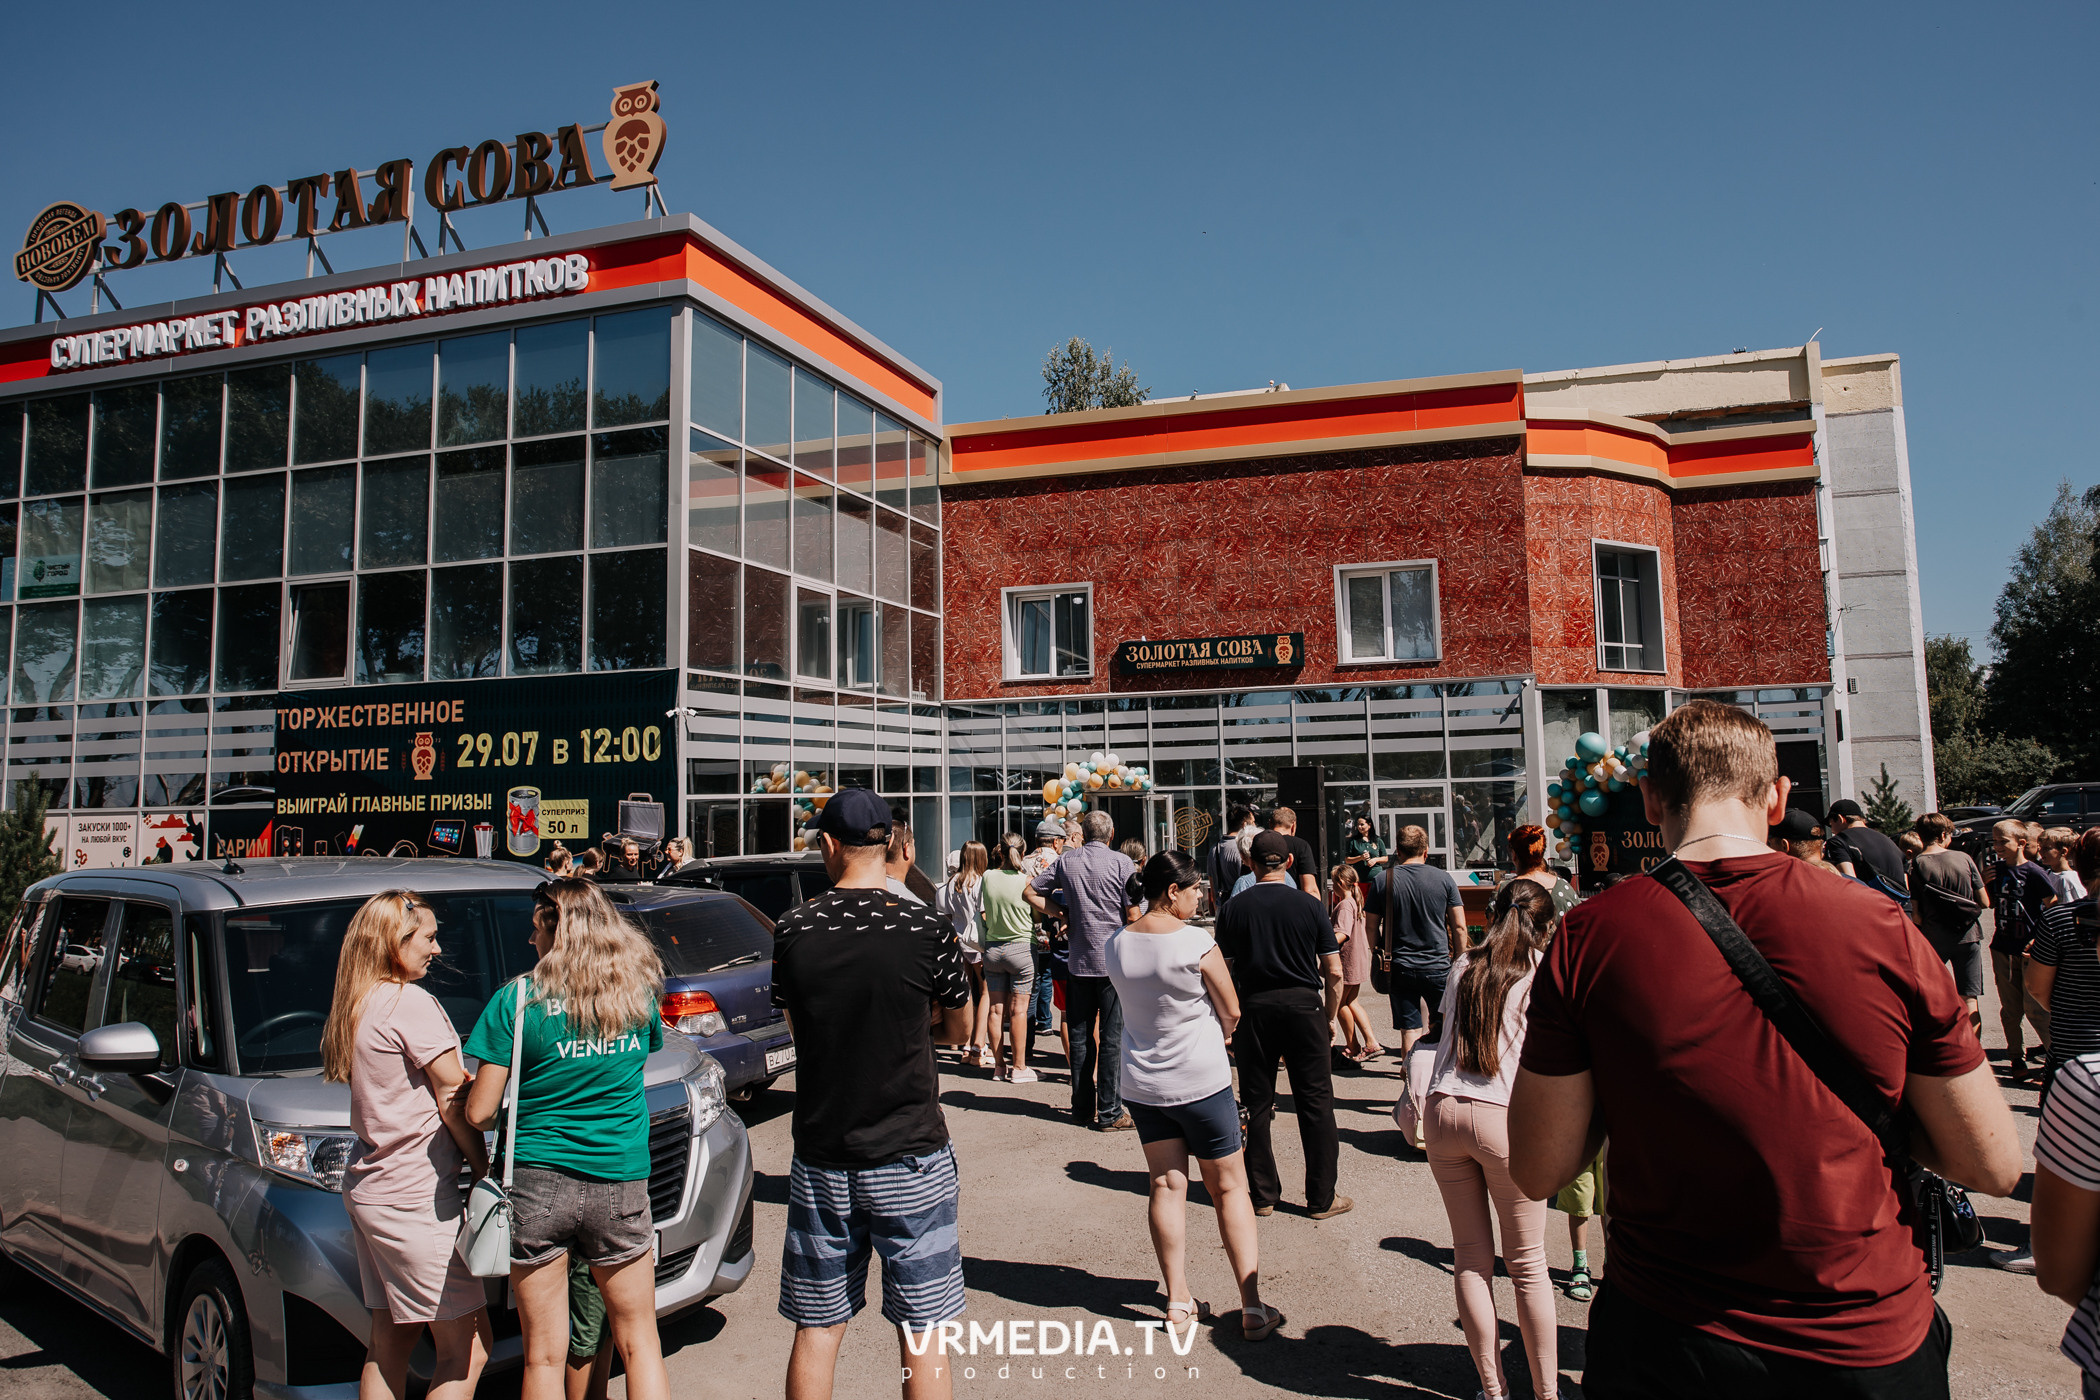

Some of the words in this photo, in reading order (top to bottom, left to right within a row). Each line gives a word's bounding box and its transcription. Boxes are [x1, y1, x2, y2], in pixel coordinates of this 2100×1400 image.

[105, 158, 413, 269] ЗОЛОТАЯ
[424, 122, 598, 213] СОВА
[19, 217, 96, 273] НОВОКЕМ
[51, 310, 239, 370] СУПЕРМАРКЕТ
[245, 281, 421, 341] РАЗЛИВНЫХ
[424, 253, 589, 312] НАПИТКОВ
[1126, 642, 1210, 663] ЗОЛОТАЯ
[1217, 639, 1263, 657] СОВА
[1136, 660, 1180, 670] СУПЕРМАРКЕТ
[1181, 658, 1219, 667] РАЗЛИВНЫХ
[1220, 656, 1254, 665] НАПИТКОВ
[277, 700, 465, 730] ТОРЖЕСТВЕННОЕ
[457, 731, 539, 768] 29.07
[580, 725, 661, 764] 12:00
[278, 748, 389, 774] ОТКРЫТИЕ
[277, 792, 348, 815] ВЫИГРАЙ
[352, 795, 426, 813] ГЛАВНЫЕ
[430, 793, 492, 811] ПРИЗЫ!
[541, 808, 586, 816] СУПЕРПРИЗ
[78, 823, 111, 832] ЗАКУСКИ
[112, 822, 132, 832] 1000+
[81, 836, 90, 844] НА
[90, 833, 111, 843] ЛЮБОЙ
[112, 834, 128, 843] ВКУС
[547, 820, 566, 834] 50
[216, 838, 269, 858] ВАРИМ
[1621, 831, 1665, 849] ЗОЛО
[556, 1033, 641, 1059] VENETA
